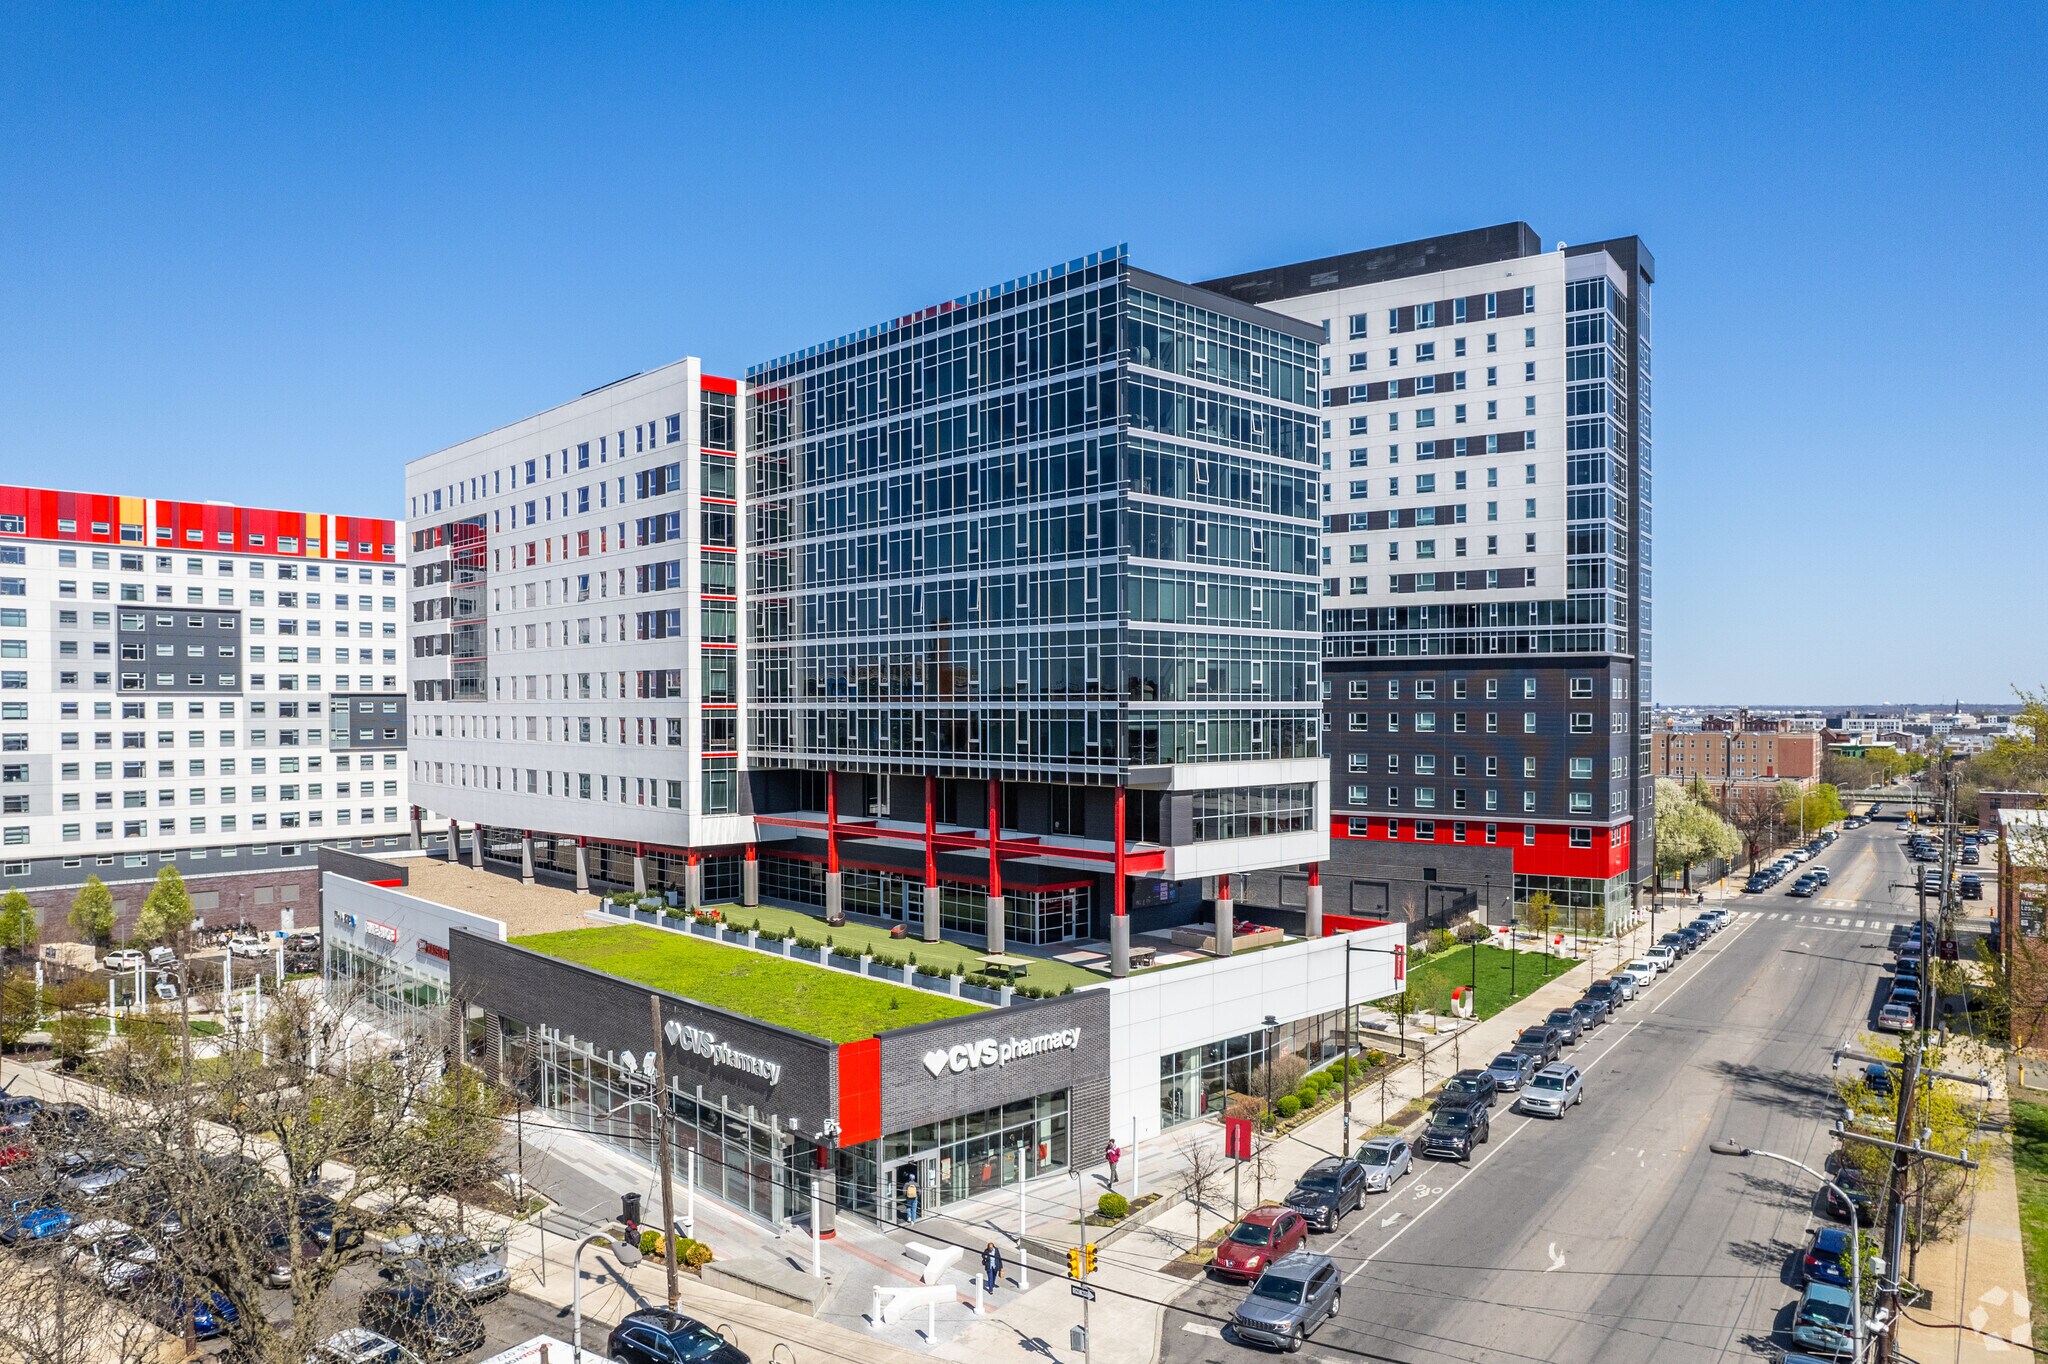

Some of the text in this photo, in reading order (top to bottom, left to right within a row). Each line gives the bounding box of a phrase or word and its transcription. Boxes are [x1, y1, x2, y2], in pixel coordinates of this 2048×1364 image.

[680, 1025, 781, 1086] CVS pharmacy
[948, 1027, 1081, 1072] CVS pharmacy
